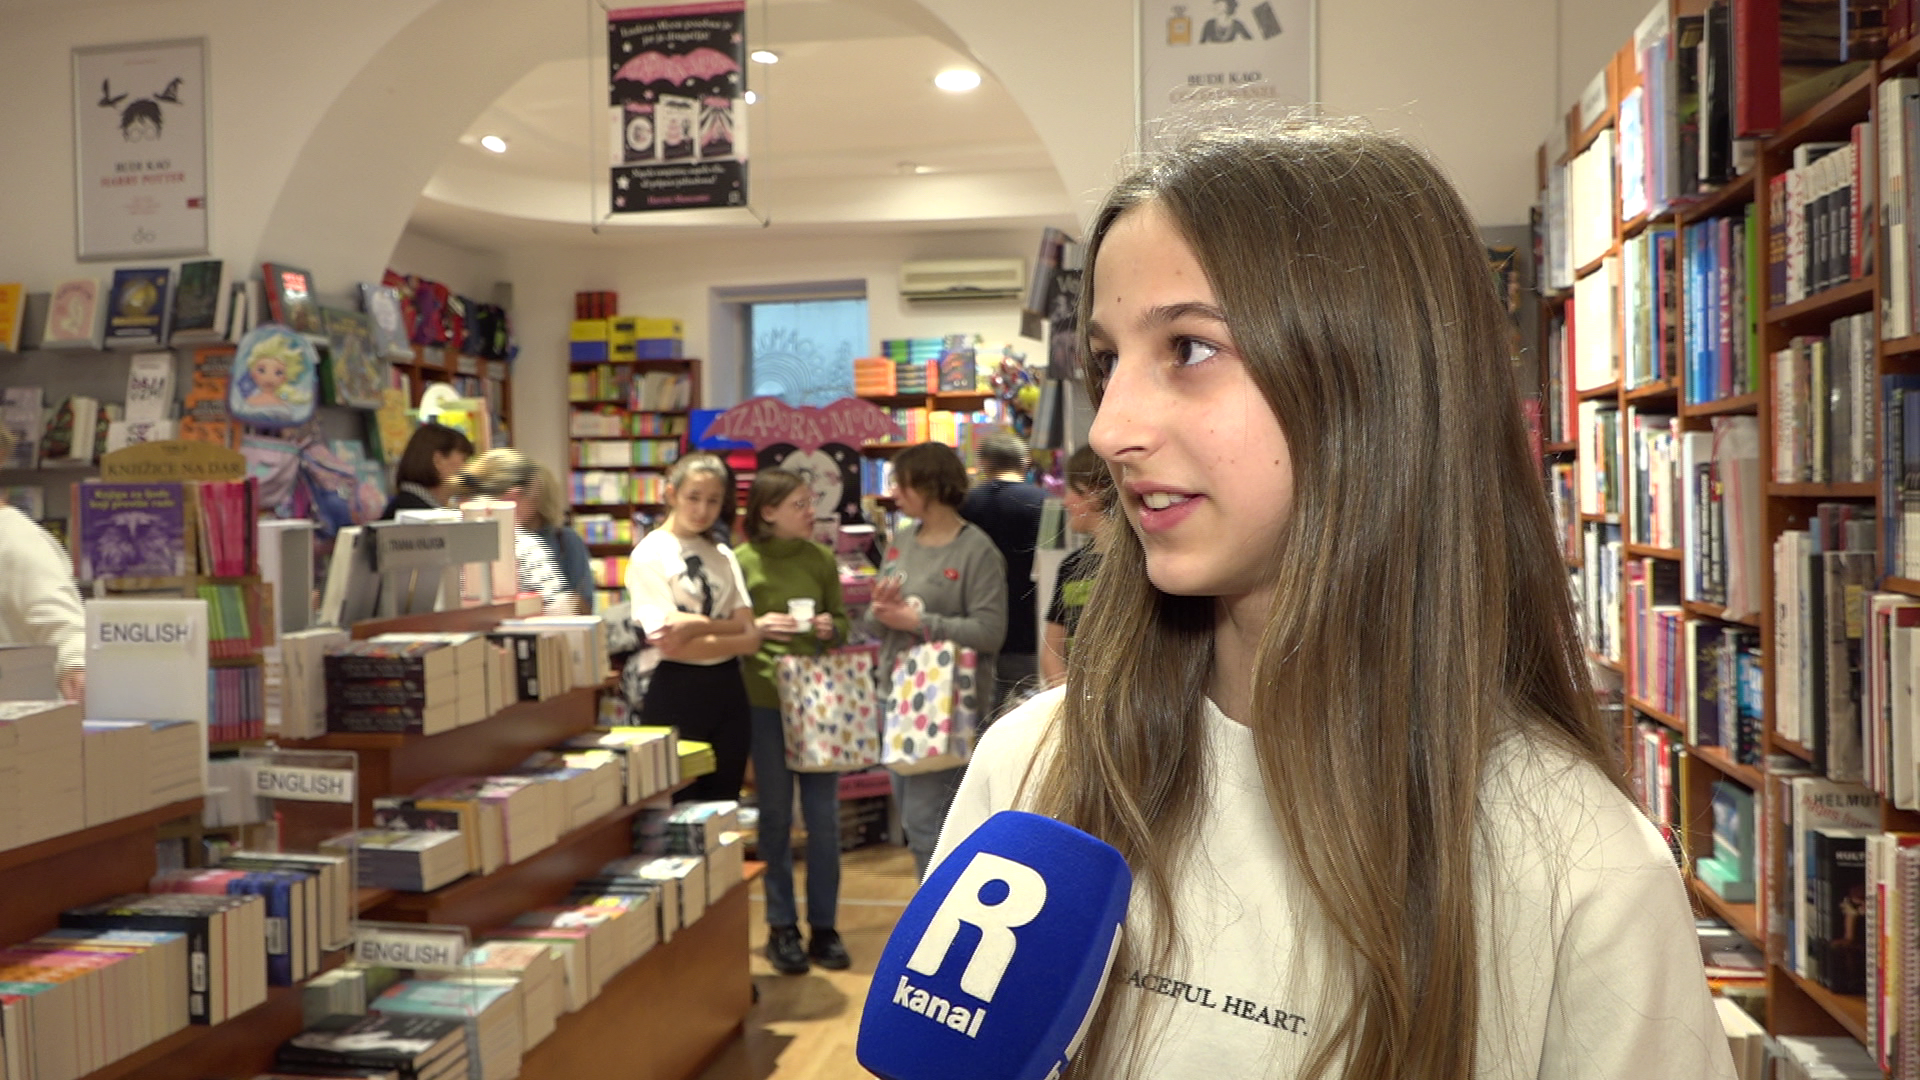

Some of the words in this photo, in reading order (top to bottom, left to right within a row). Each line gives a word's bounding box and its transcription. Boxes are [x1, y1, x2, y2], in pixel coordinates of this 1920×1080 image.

[1229, 71, 1261, 84] KAO
[100, 175, 138, 188] HARRY
[141, 171, 185, 185] POTTER
[721, 400, 825, 444] IZADORA
[182, 462, 204, 475] NA
[99, 621, 190, 643] ENGLISH
[256, 769, 345, 796] ENGLISH
[1814, 793, 1880, 808] HELMUT
[361, 940, 449, 965] ENGLISH
[892, 974, 988, 1040] kanal
[1221, 995, 1309, 1037] HEART.
